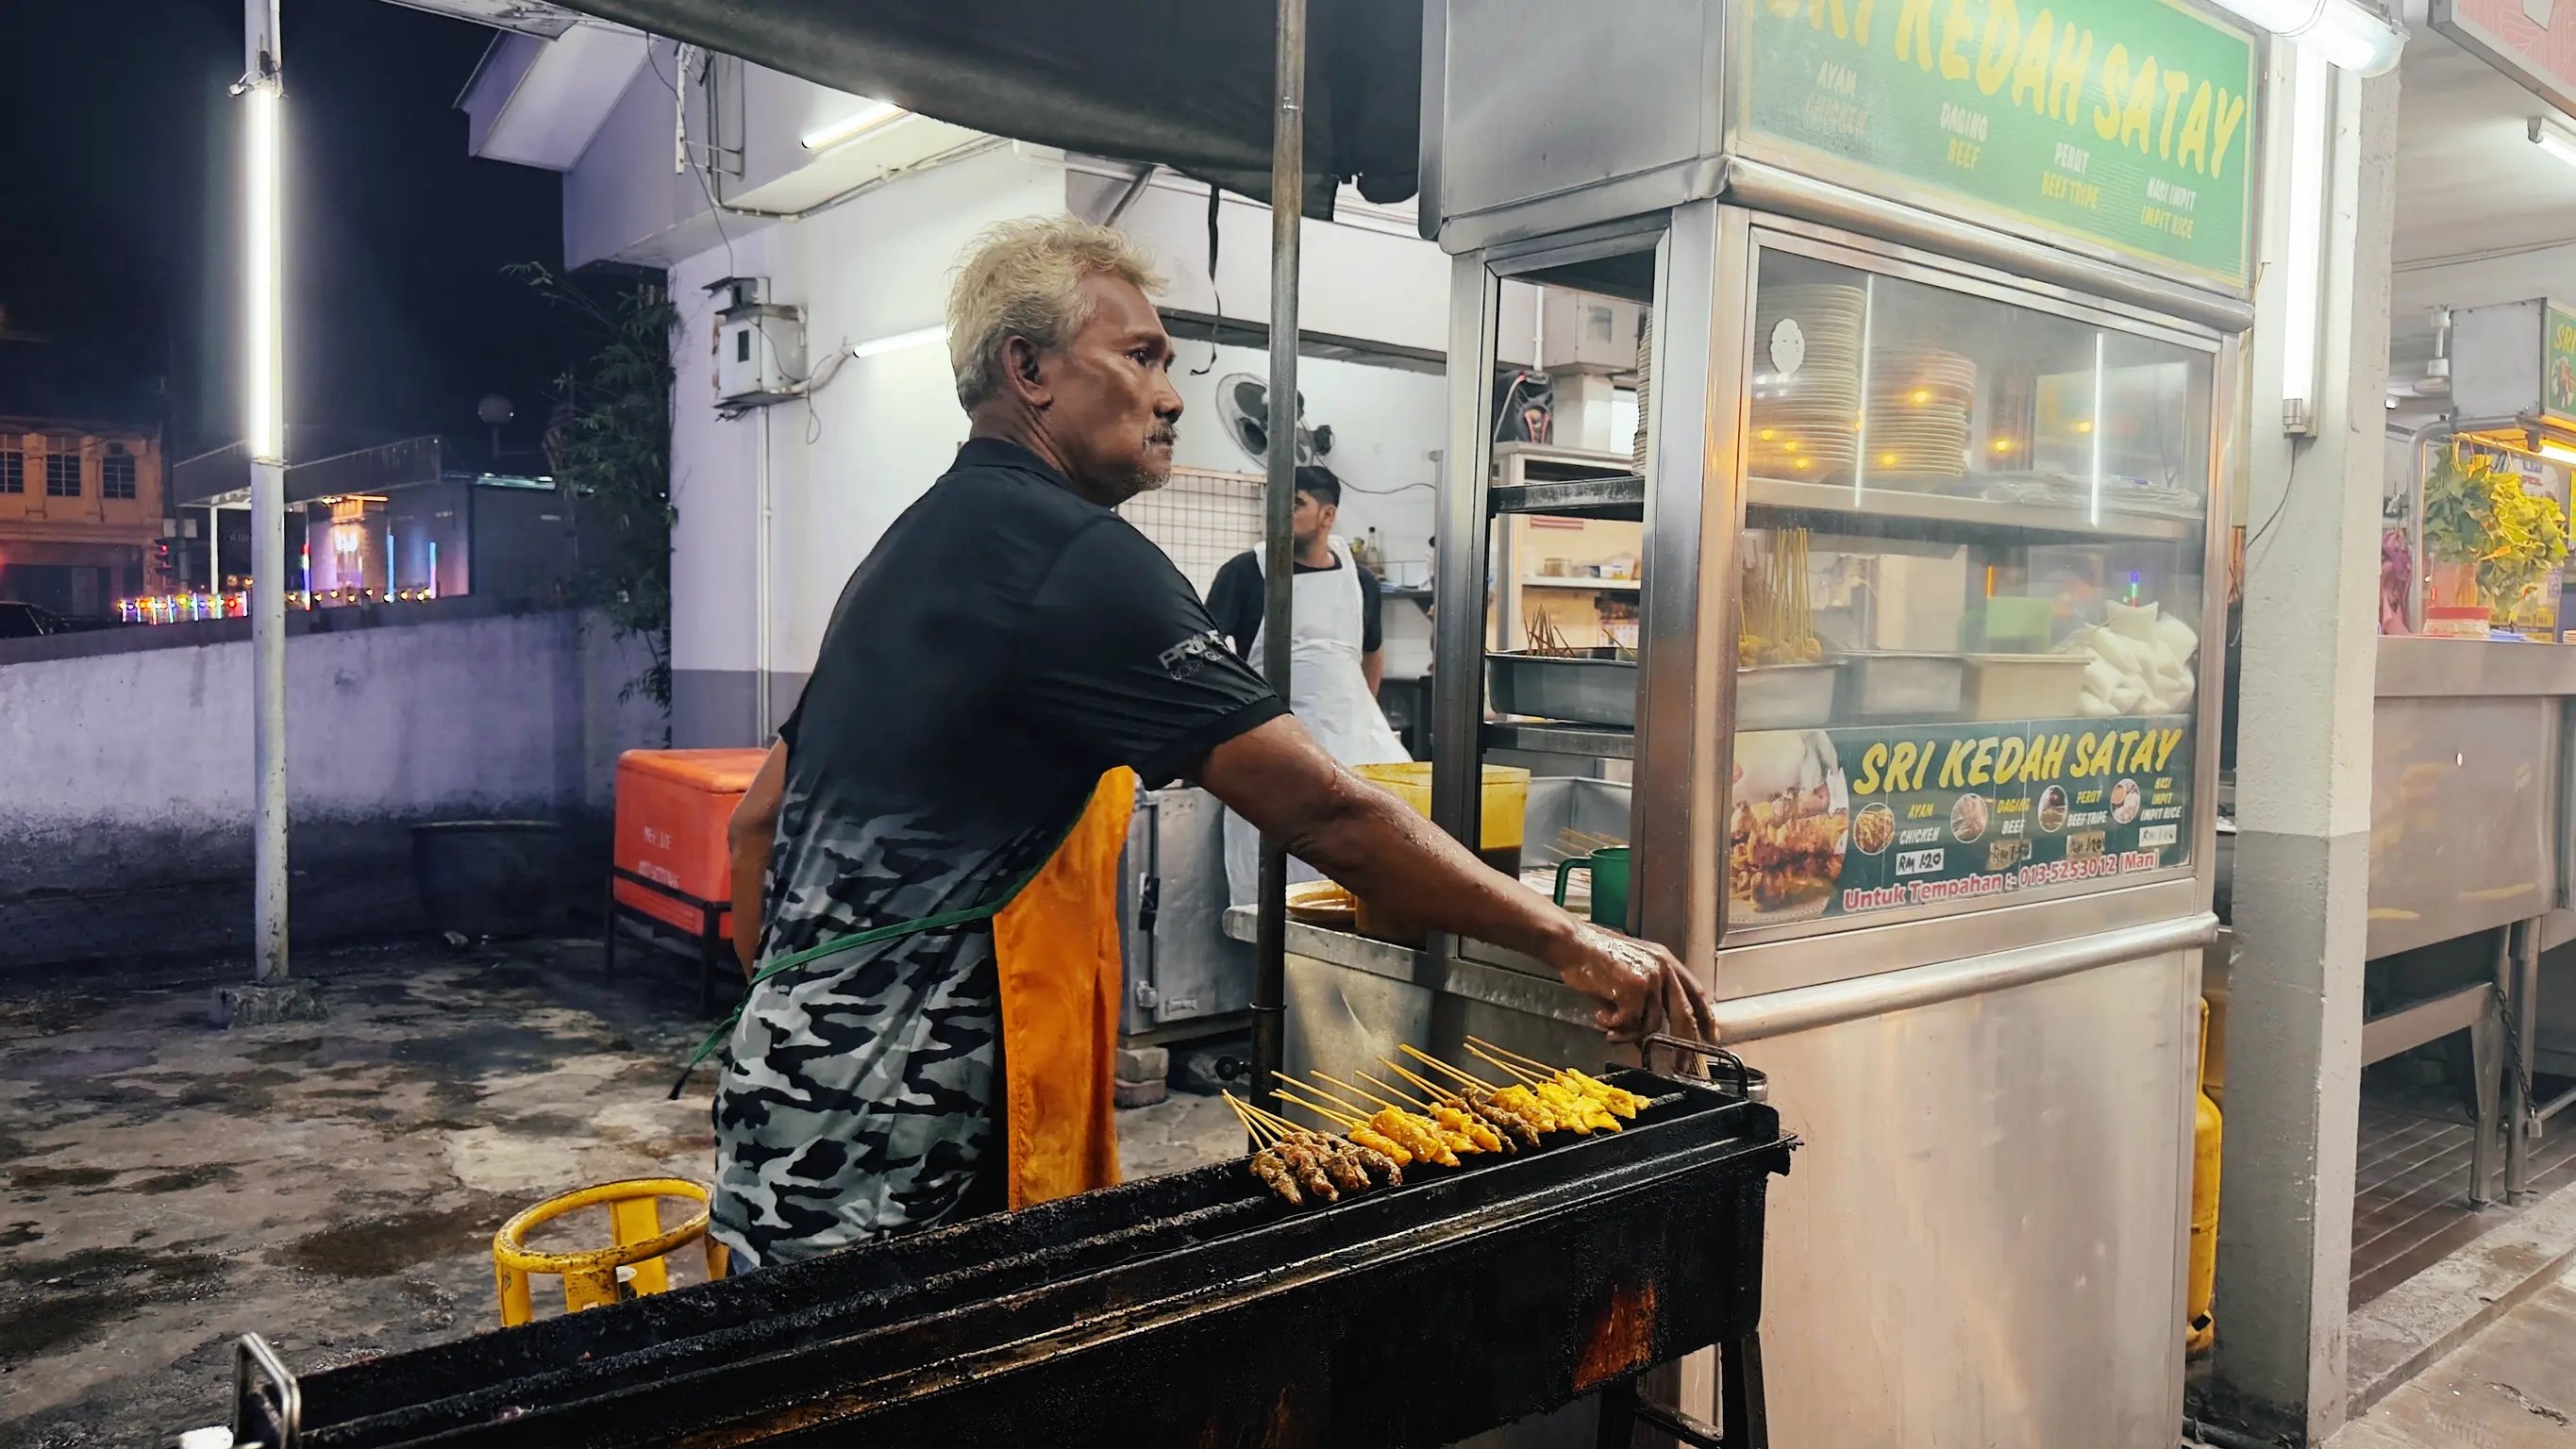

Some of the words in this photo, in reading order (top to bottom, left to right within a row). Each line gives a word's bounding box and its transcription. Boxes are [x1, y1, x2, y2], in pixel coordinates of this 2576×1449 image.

[2093, 43, 2244, 178] SATAY
[1948, 138, 1981, 172] BEEF
[2053, 142, 2089, 174] PERUT
[2041, 171, 2067, 200] BEEF
[1853, 741, 1935, 795] SRI
[1939, 734, 2070, 789] KEDAH
[2070, 728, 2183, 776] SATAY
[2076, 790, 2102, 804] PERUT
[1907, 804, 1934, 819] AYAM
[2066, 812, 2087, 827] BEEF
[2086, 810, 2107, 824] TRIPE
[2140, 808, 2164, 821] IMPIT
[2163, 806, 2183, 819] RICE
[1899, 826, 1940, 844] CHICKEN
[2001, 820, 2026, 835] BEEF
[1899, 855, 1915, 872] RM
[1844, 885, 1905, 910] Untuk
[1909, 874, 2002, 903] Tempahan
[2019, 853, 2116, 886] 013-5253012
